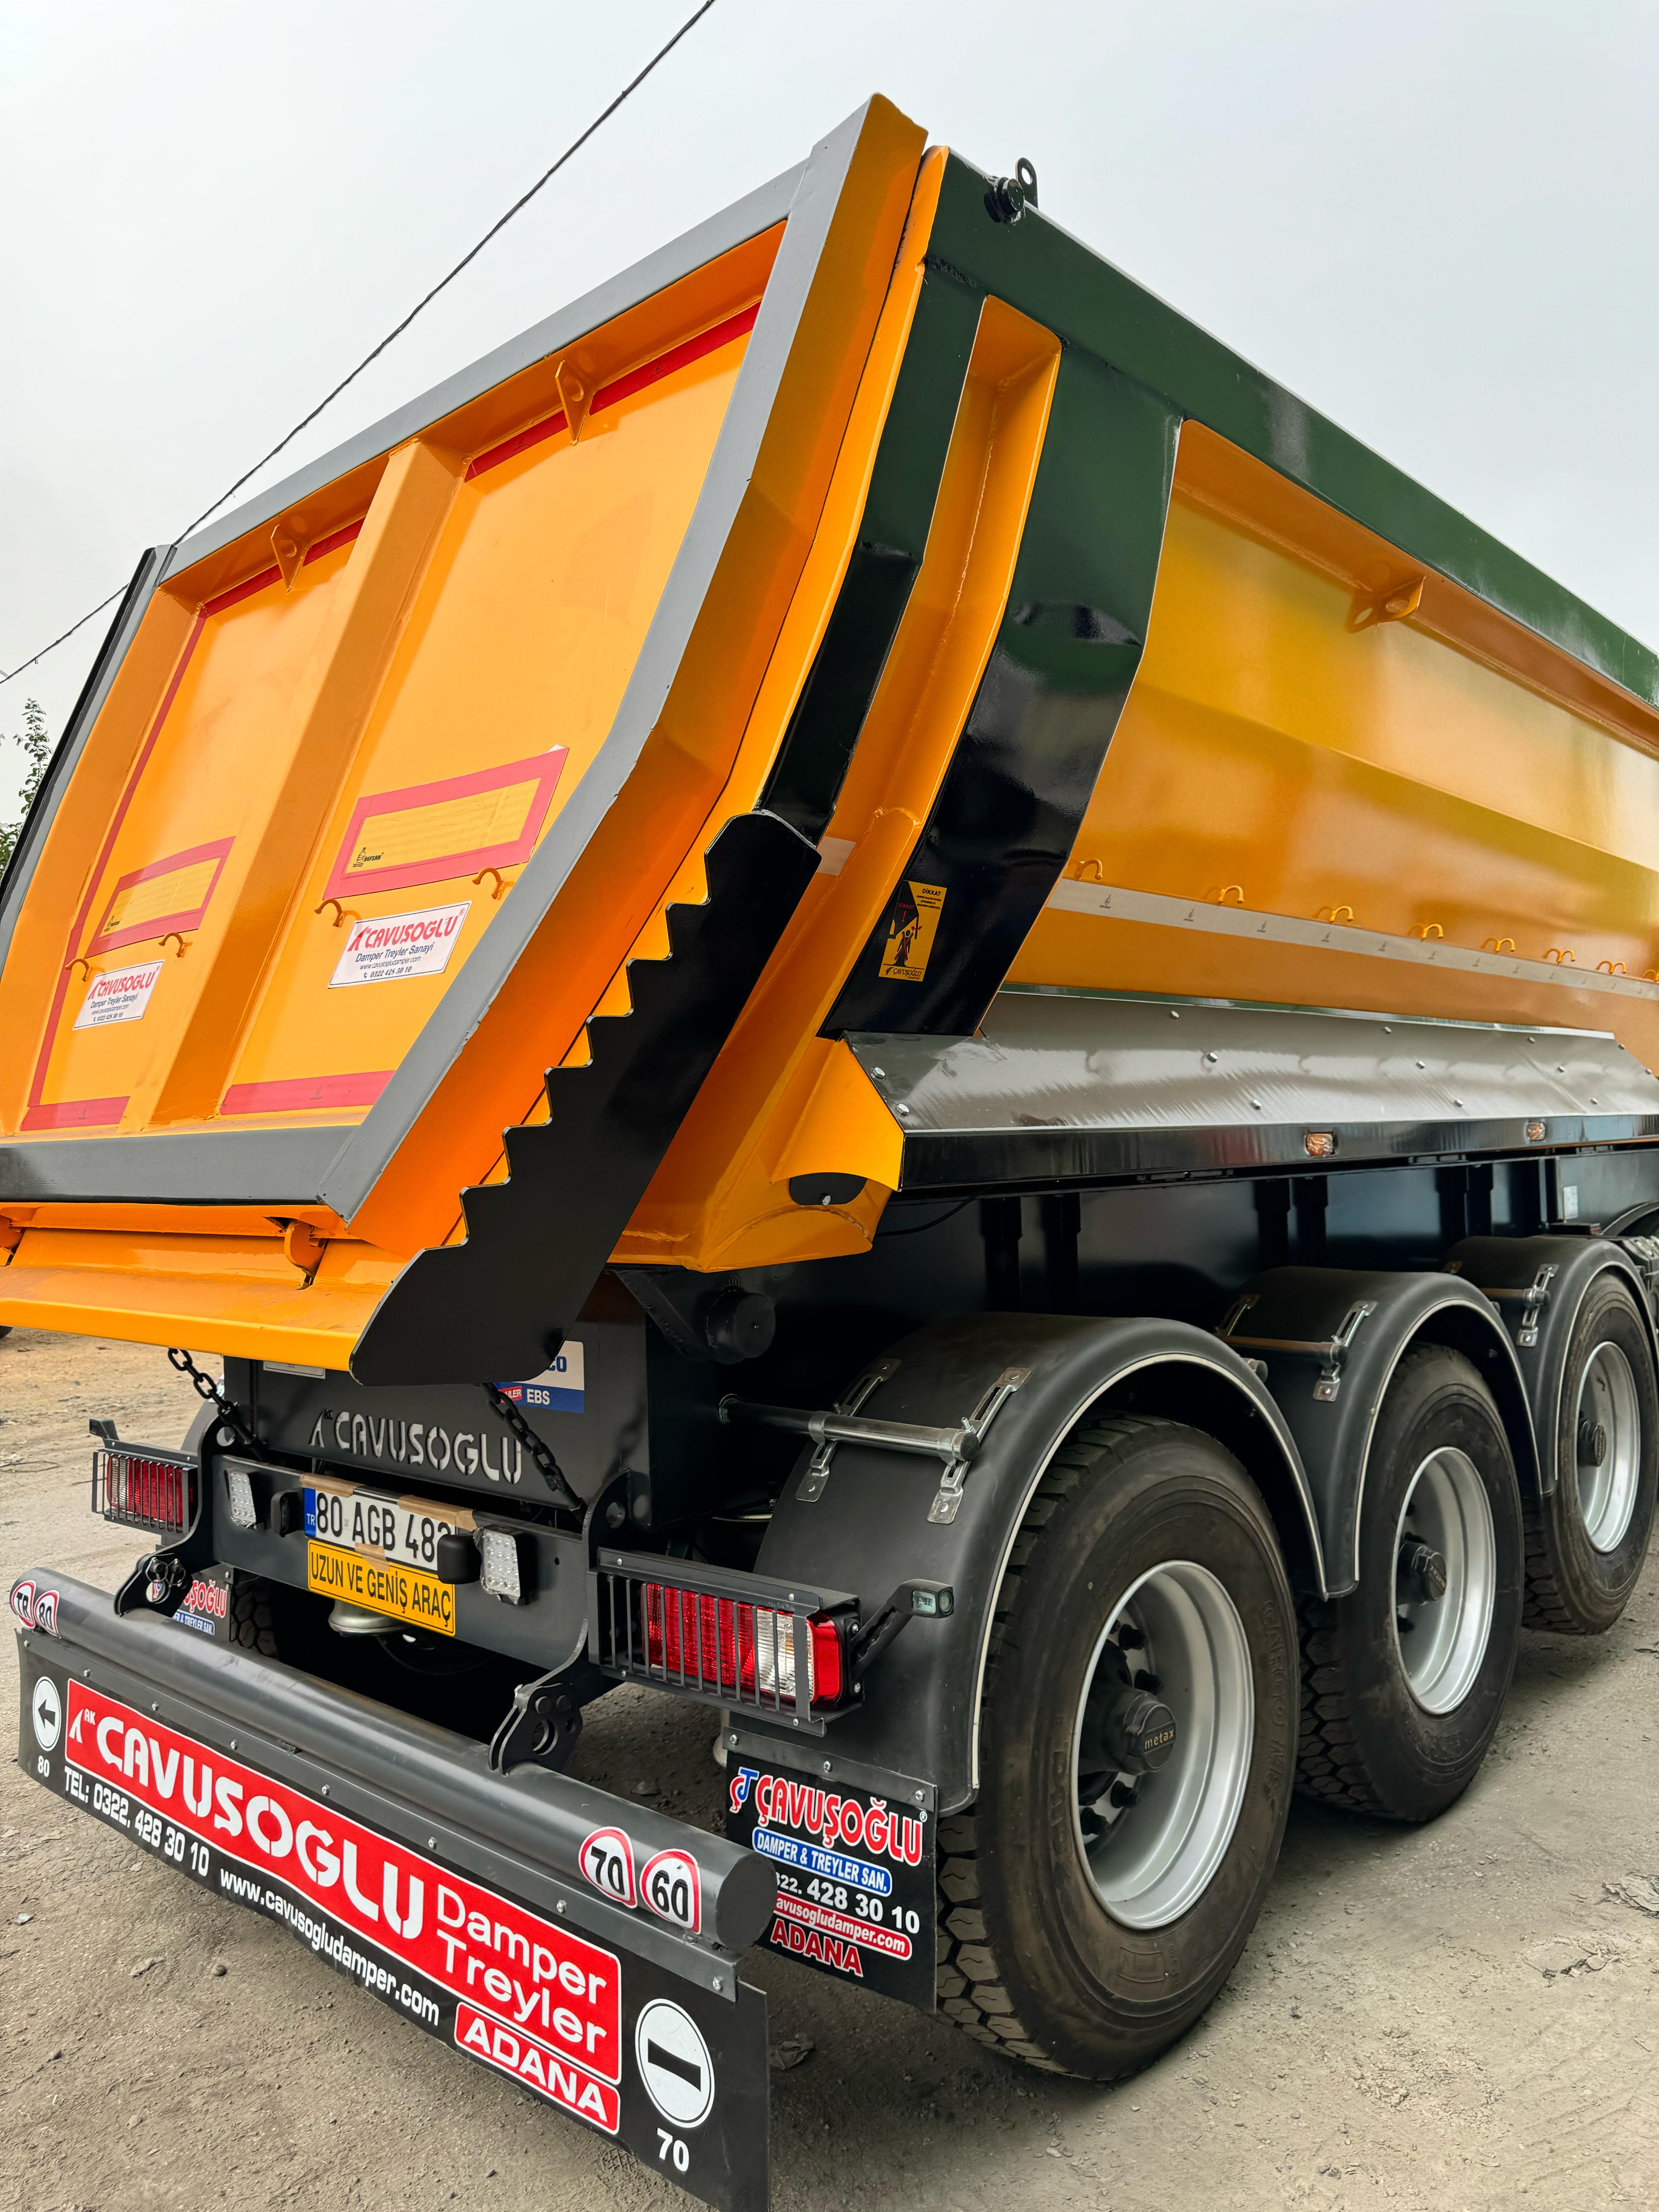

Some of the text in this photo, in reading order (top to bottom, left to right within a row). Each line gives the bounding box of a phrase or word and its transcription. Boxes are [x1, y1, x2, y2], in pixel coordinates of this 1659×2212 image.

[922, 888, 941, 897] DİKKAT
[355, 942, 435, 963] Damper Treyler Sanayi
[365, 915, 459, 948] CAVUSOGLU
[527, 1389, 550, 1405] EBS
[334, 1411, 521, 1485] CAVUSOGLU
[306, 1513, 315, 1526] TR
[317, 1493, 342, 1537] 80
[353, 1502, 395, 1551] AGB
[16, 1592, 31, 1621] TR
[39, 1602, 53, 1630] 80
[311, 1551, 451, 1627] UZUN VE GENİŞ ARAÇ
[38, 1755, 50, 1777] 80
[1144, 1729, 1174, 1749] metax
[84, 1708, 424, 1939] AK CAVUSOGLU
[755, 1774, 923, 1867] ÇAVUŞOĞLU
[591, 1846, 625, 1896] 70
[757, 1832, 887, 1892] DAMPER & TREYLER SAN.
[64, 1766, 89, 1803] TEL:
[135, 1809, 162, 1848] 428
[165, 1826, 185, 1862] 30
[191, 1842, 209, 1877] 10
[220, 1868, 439, 2026] www.cavusogludamper.com
[652, 1870, 688, 1922] 60
[807, 1878, 848, 1910] 428
[855, 1893, 883, 1922] 30
[891, 1906, 920, 1934] 10
[437, 1883, 607, 2005] Damper
[770, 1917, 864, 1977] ADANA
[776, 1897, 906, 1954] avusogludamper.com
[436, 1928, 607, 2054] Treyler
[463, 2017, 608, 2122] ADANA
[657, 2127, 690, 2172] 70
